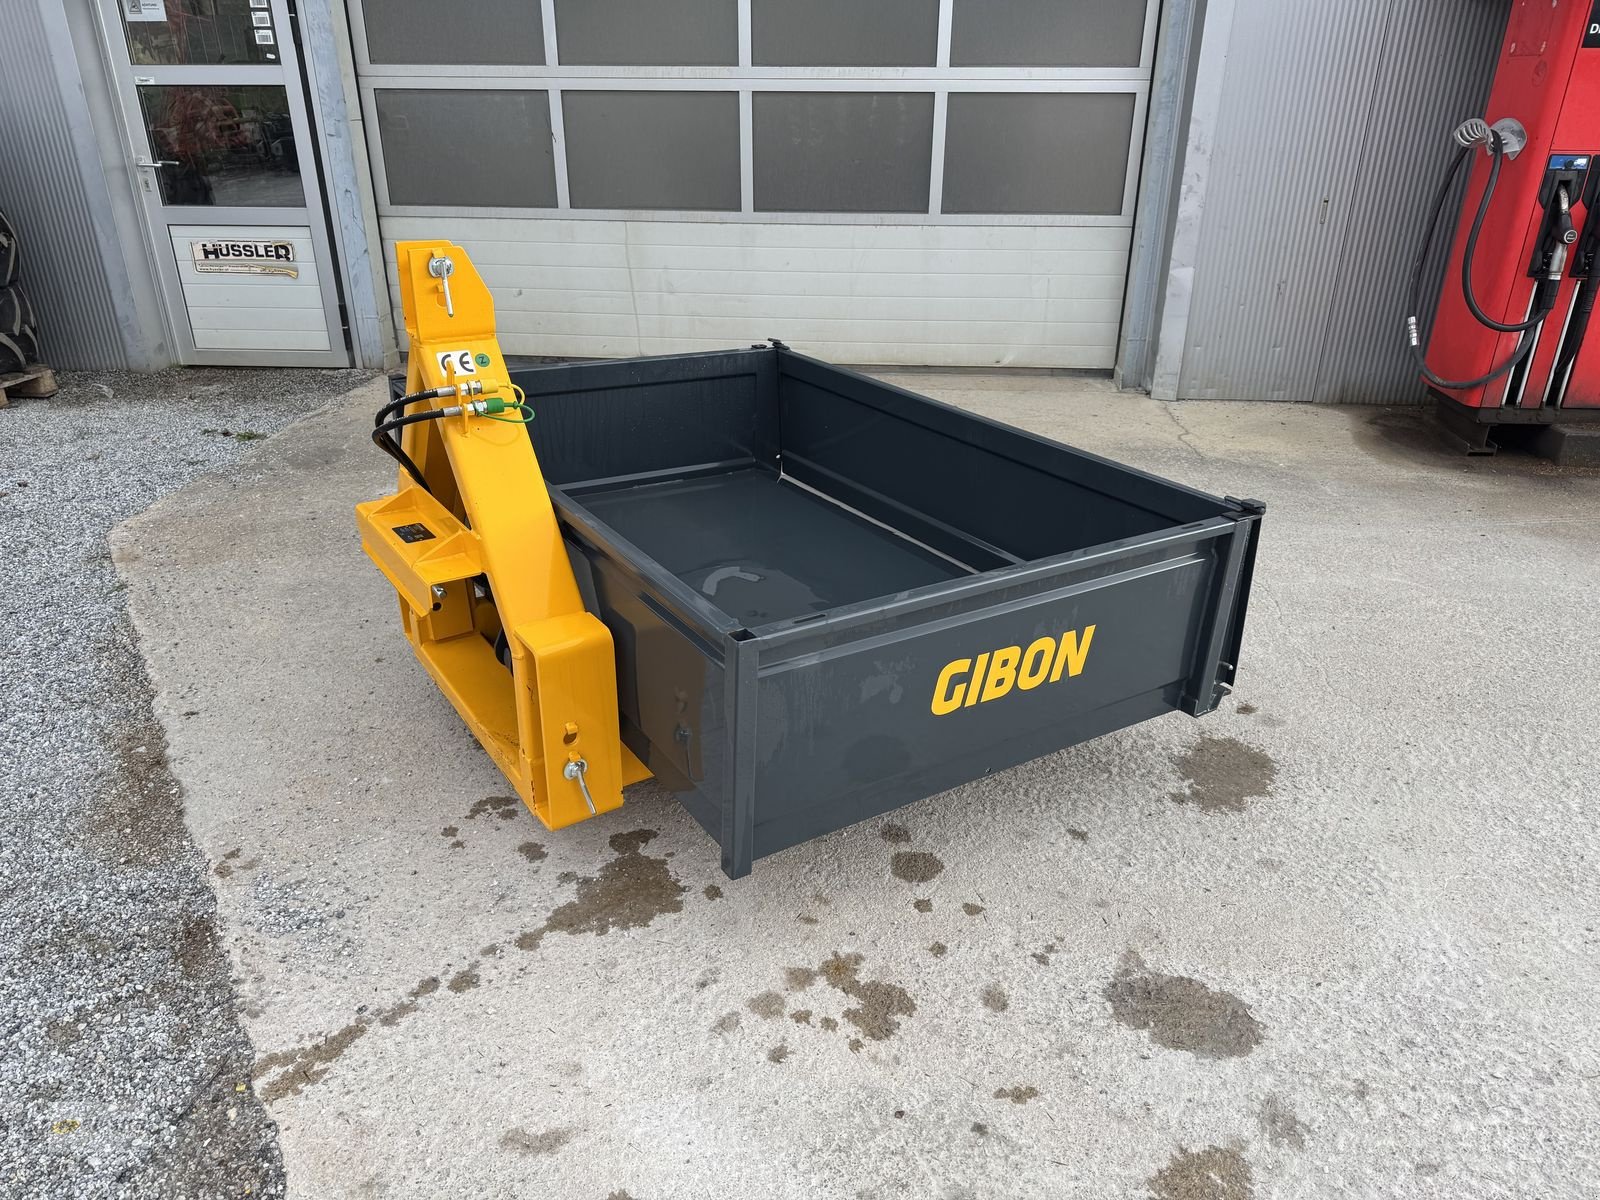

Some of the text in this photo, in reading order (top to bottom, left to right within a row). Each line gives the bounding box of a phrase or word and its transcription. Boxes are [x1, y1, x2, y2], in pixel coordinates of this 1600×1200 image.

[201, 243, 291, 261] HÜSSLER
[441, 352, 474, 374] CE
[931, 624, 1097, 716] GIBON
